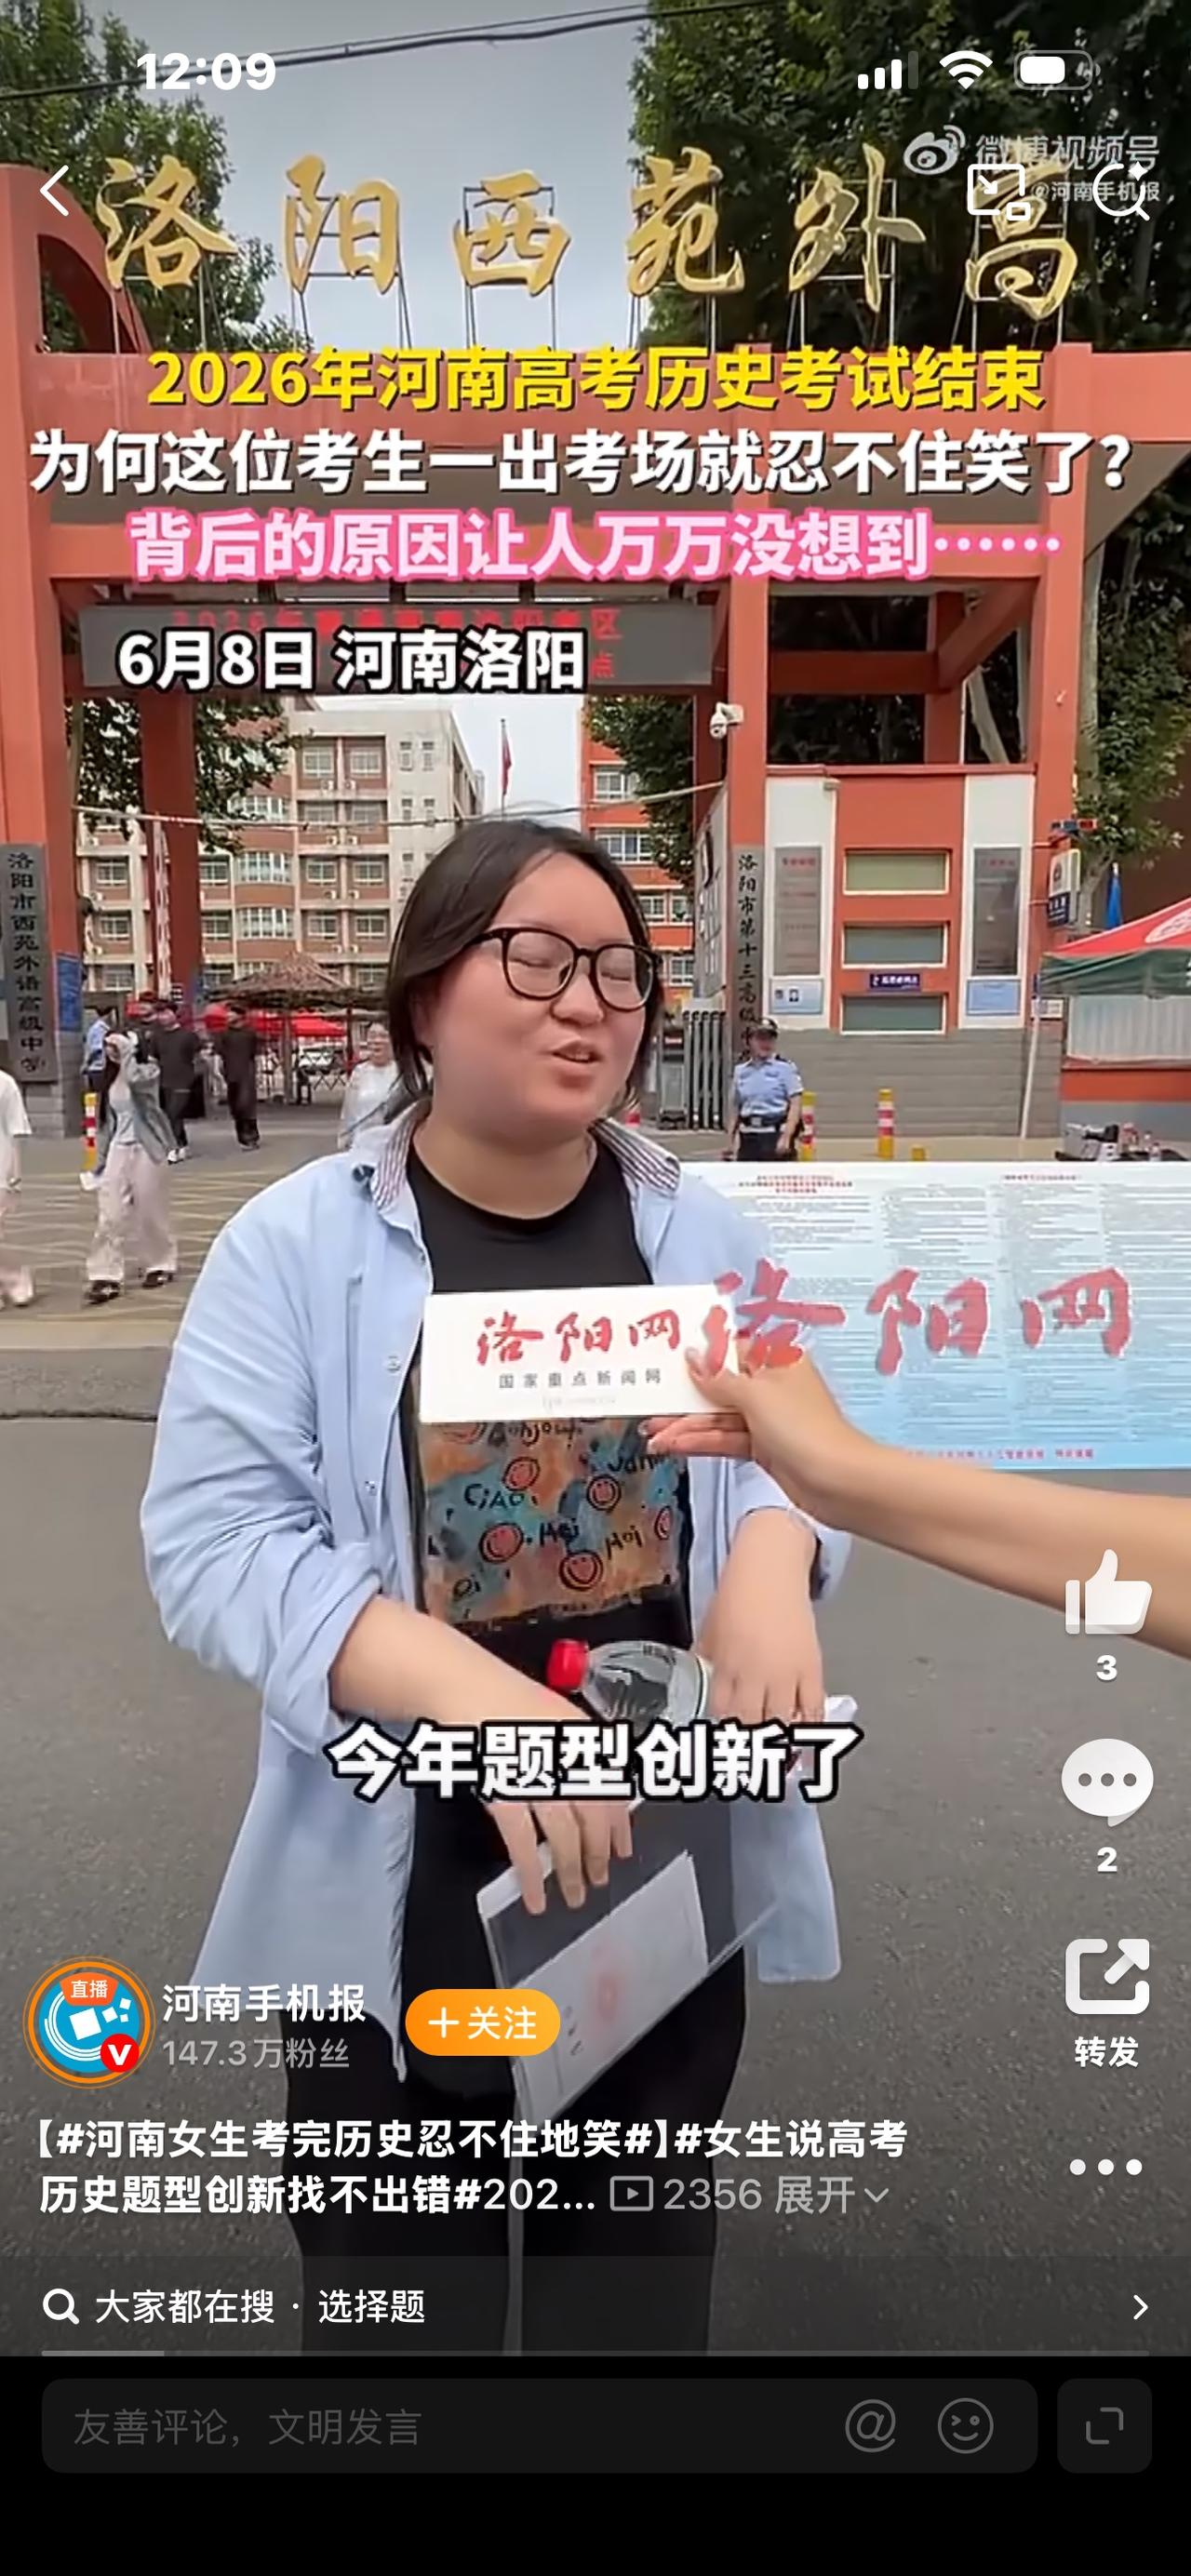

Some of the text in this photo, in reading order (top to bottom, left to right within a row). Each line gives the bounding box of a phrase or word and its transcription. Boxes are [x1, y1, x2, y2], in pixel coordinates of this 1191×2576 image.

[7, 852, 45, 1072] 洛阳市西苑外语高级中学
[476, 1309, 680, 1366] 洛阳网
[499, 1368, 662, 1389] 国家重点新闻网
